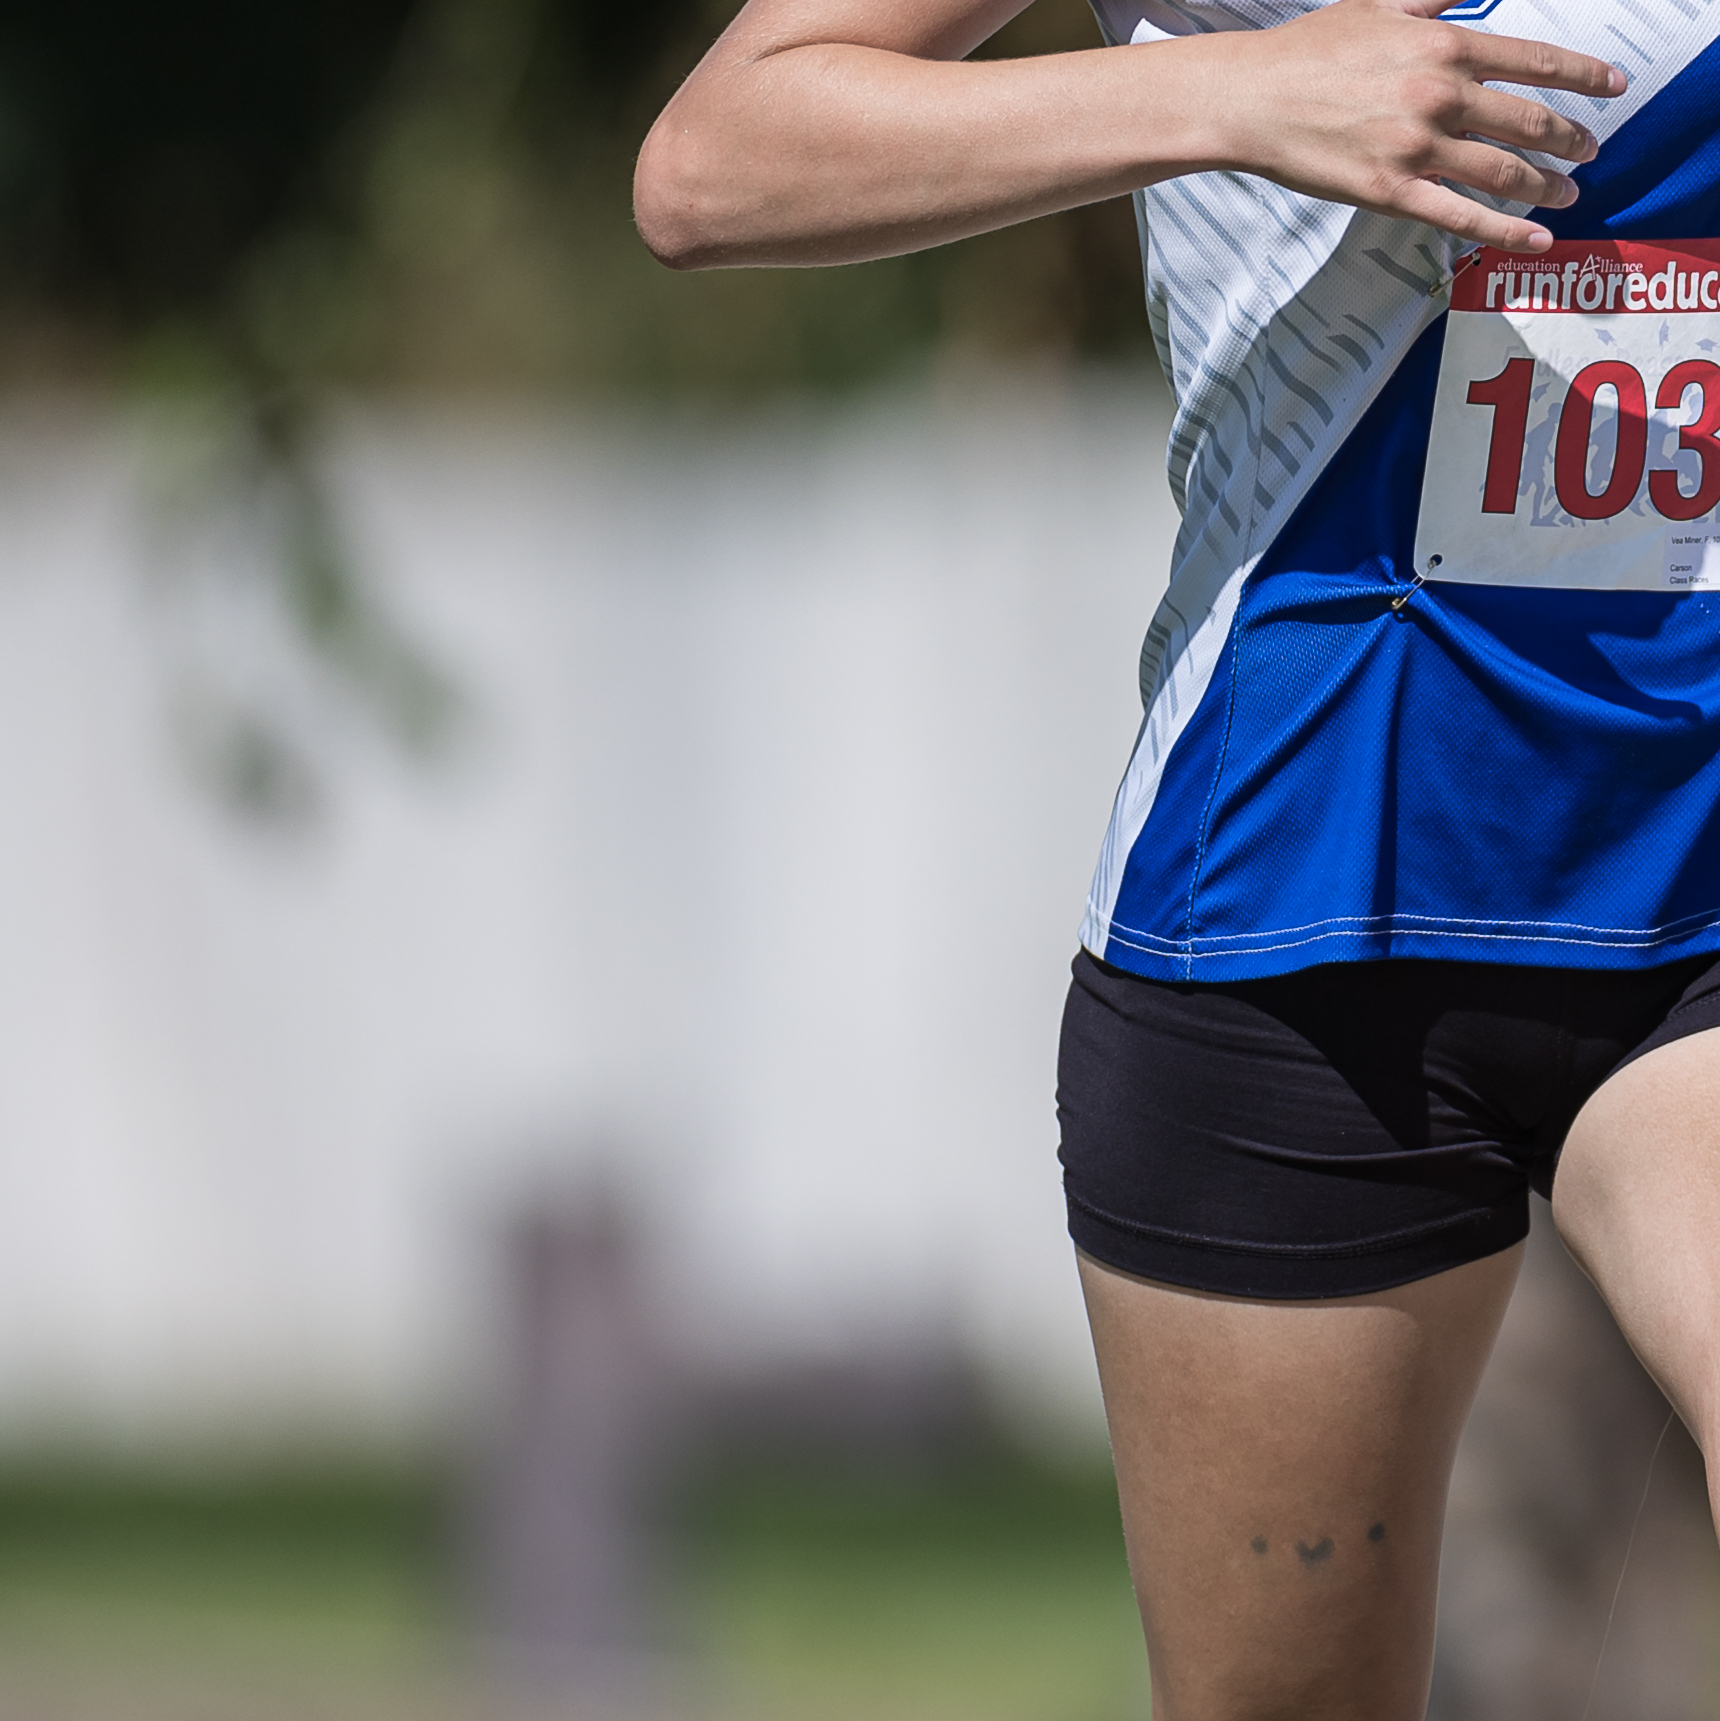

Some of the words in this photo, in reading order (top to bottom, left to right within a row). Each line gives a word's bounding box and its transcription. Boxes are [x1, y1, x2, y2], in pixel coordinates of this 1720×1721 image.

[1497, 257, 1561, 273] education
[1669, 564, 1692, 572] Carson
[1669, 576, 1688, 584] Class
[1689, 576, 1709, 584] Races
